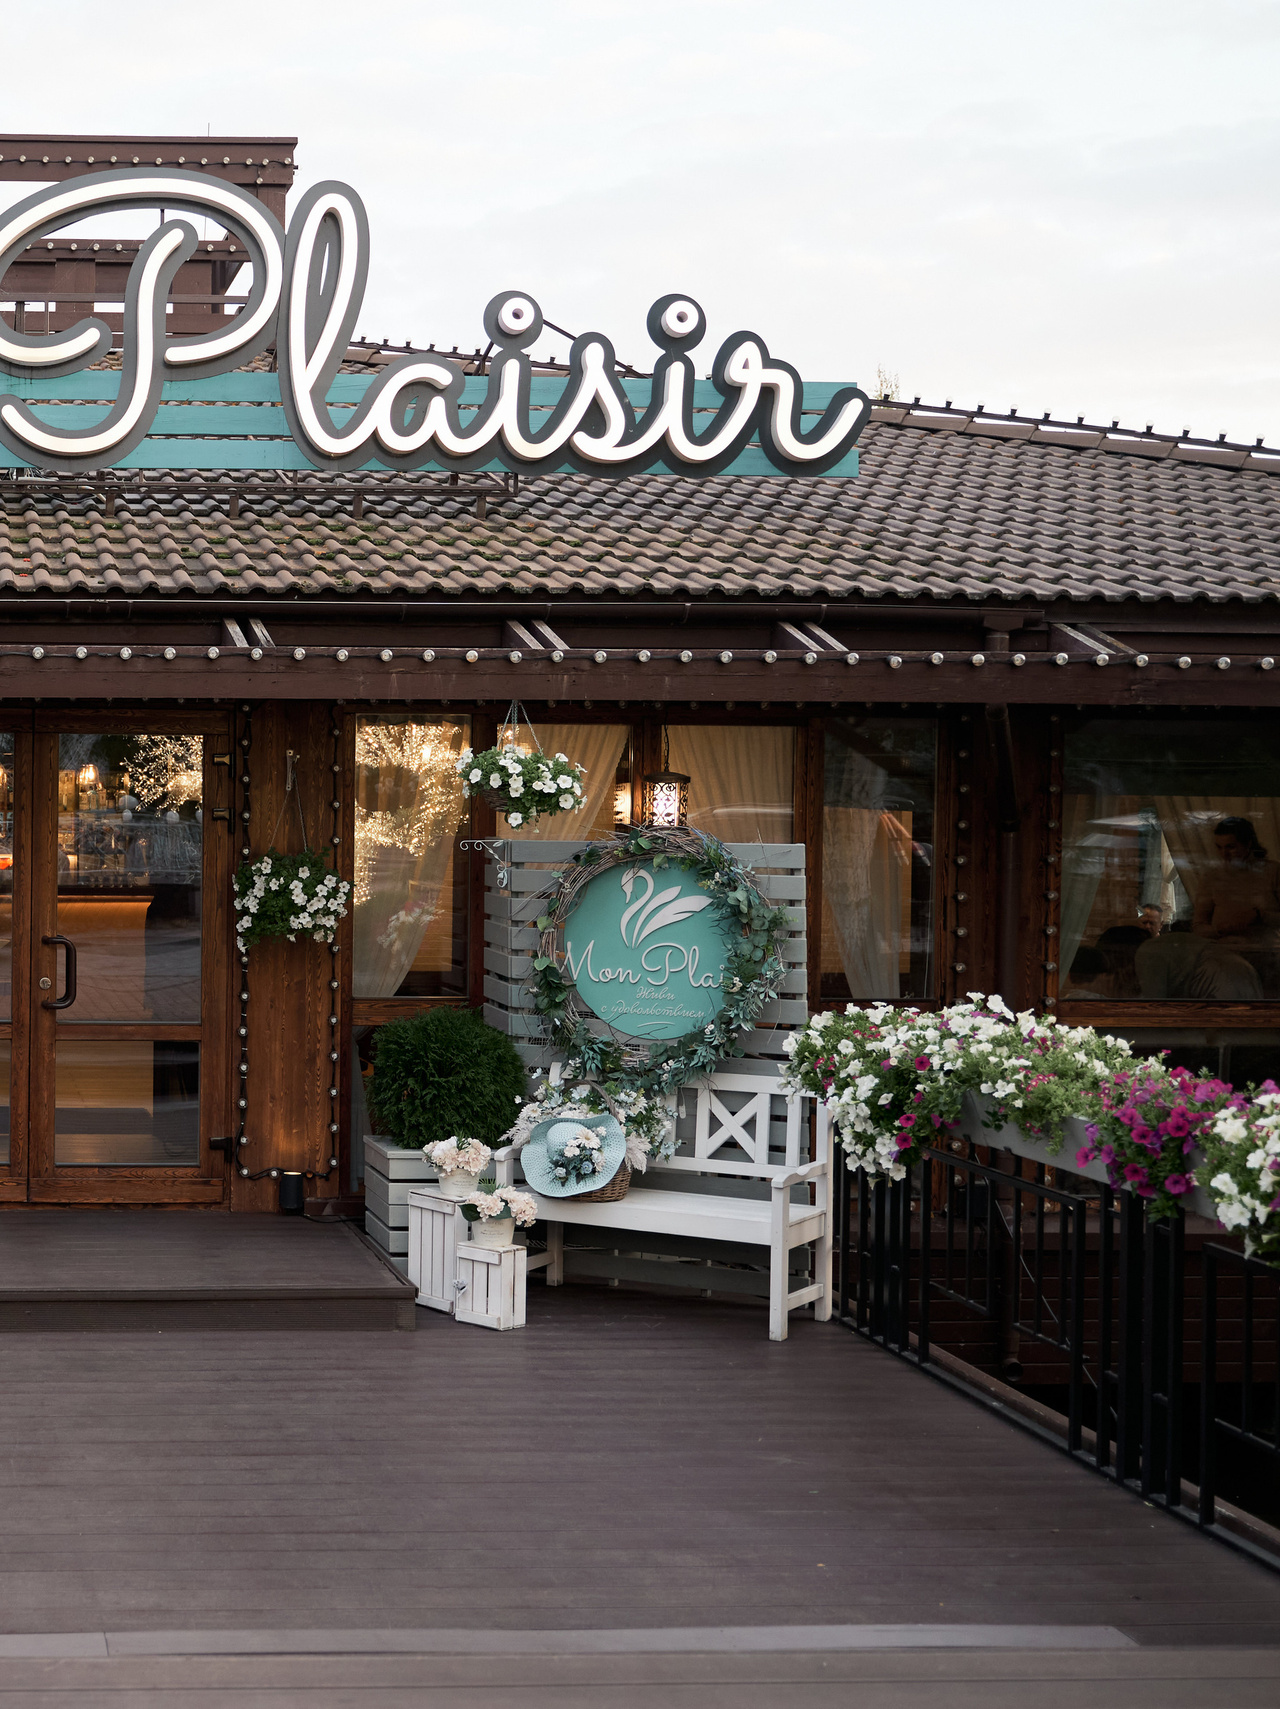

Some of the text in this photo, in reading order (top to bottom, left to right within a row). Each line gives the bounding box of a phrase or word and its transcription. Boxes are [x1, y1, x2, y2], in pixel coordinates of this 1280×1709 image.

[558, 940, 724, 988] Mon Plai
[636, 986, 675, 1000] Живи
